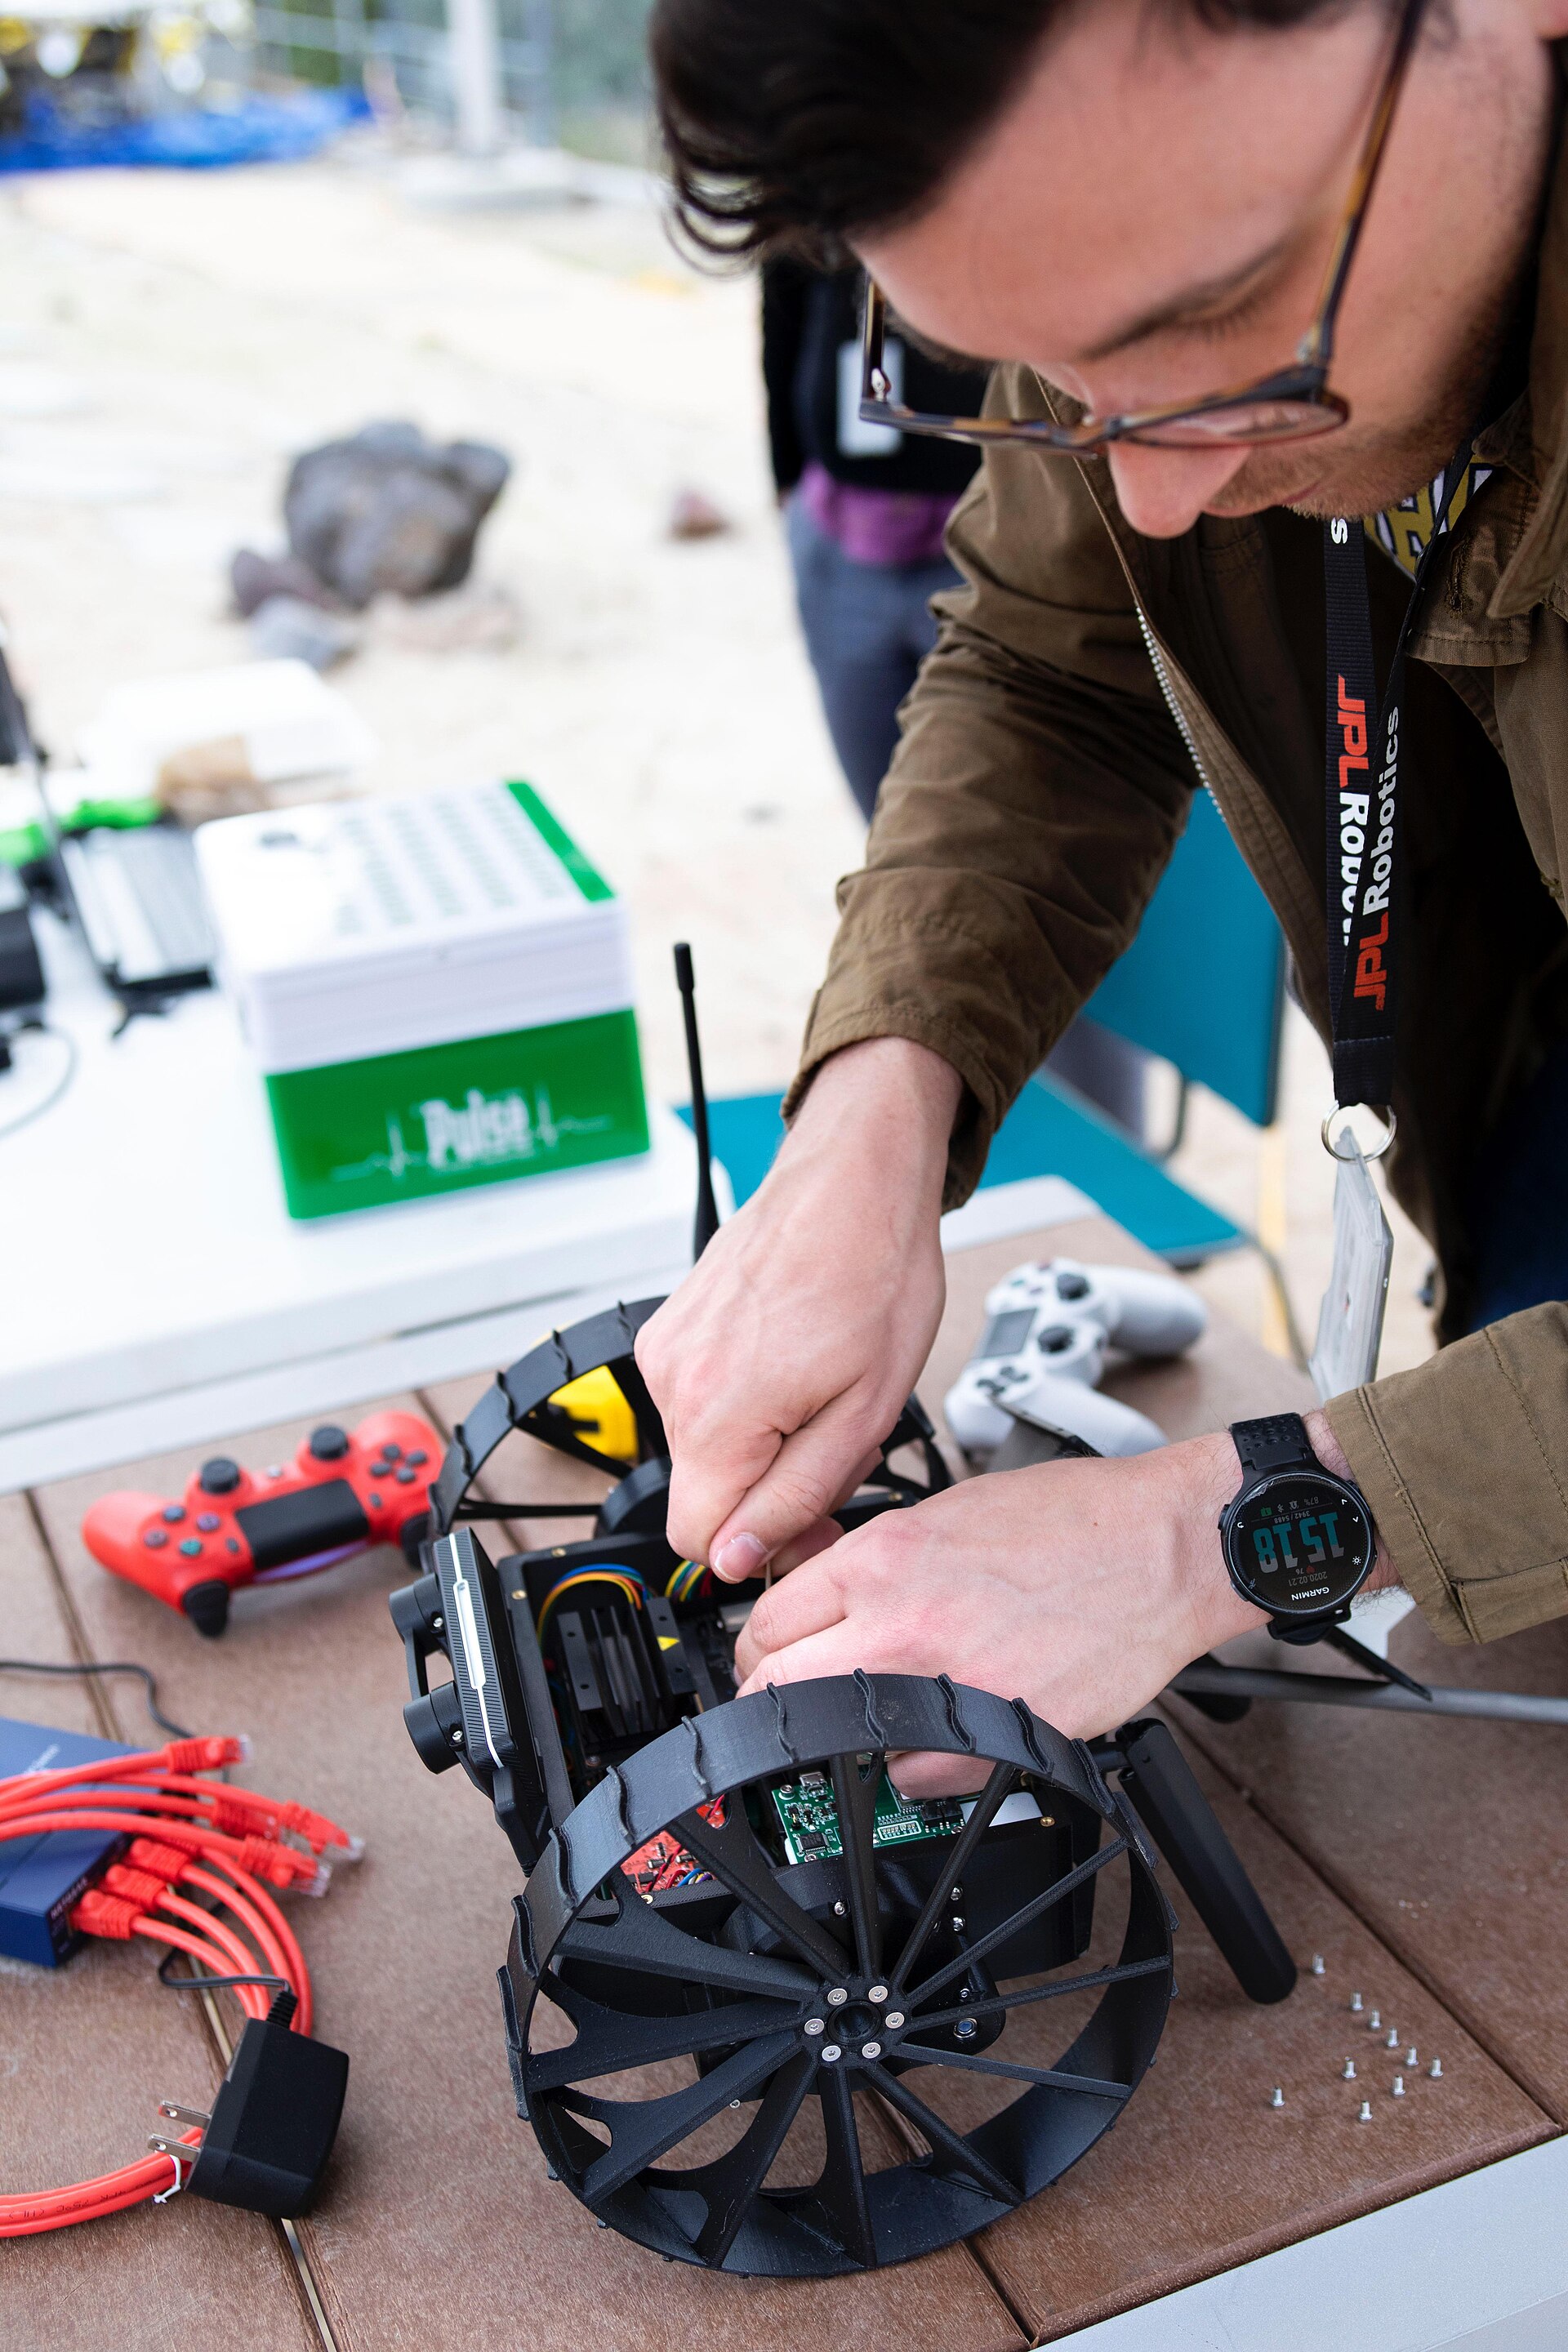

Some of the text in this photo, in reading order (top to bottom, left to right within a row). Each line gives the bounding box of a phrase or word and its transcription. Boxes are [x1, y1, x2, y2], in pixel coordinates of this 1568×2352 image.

[1337, 674, 1369, 788] JPL
[1353, 706, 1399, 1011] JPL Robotics
[418, 1087, 530, 1169] Pulse
[1303, 1496, 1319, 1506] 87%
[1274, 1515, 1290, 1524] 5488
[1294, 1510, 1311, 1519] 3942
[1295, 1567, 1303, 1575] 76
[1288, 1571, 1328, 1587] 2020.02.21
[1291, 1587, 1330, 1601] GARMIN
